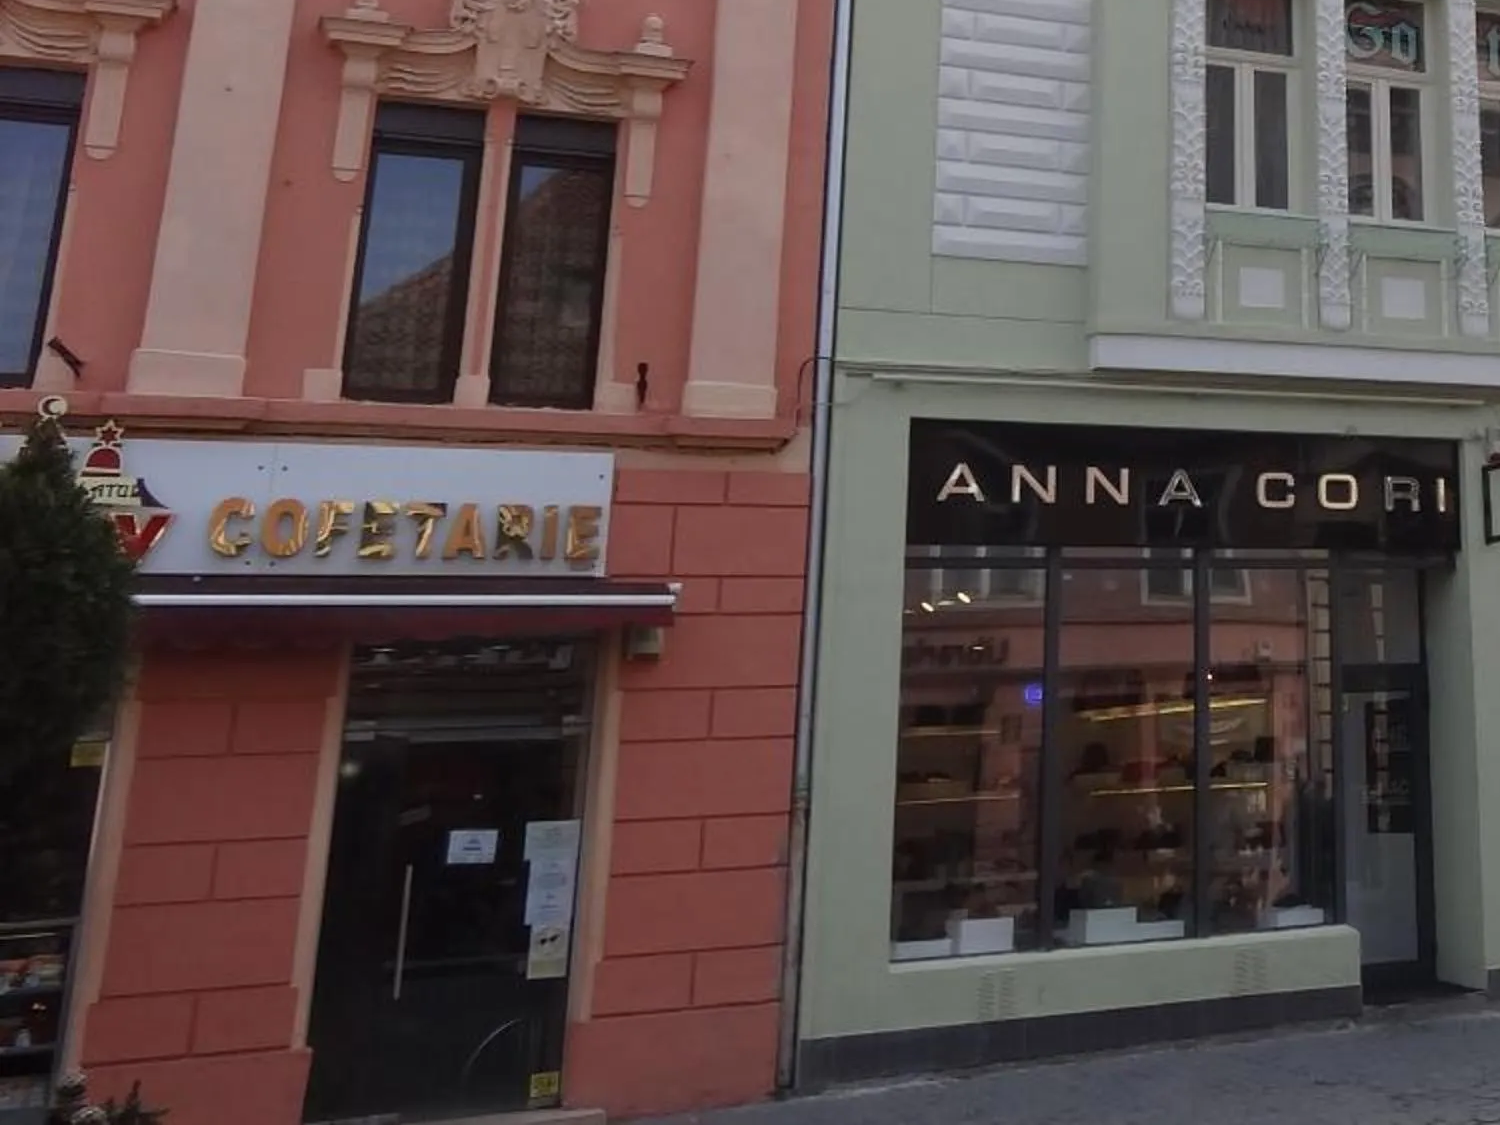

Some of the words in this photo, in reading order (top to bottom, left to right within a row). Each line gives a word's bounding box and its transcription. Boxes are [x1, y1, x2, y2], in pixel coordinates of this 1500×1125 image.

[936, 462, 1202, 507] ANNA
[1256, 472, 1446, 513] CORI
[207, 496, 603, 563] COFETARIE
